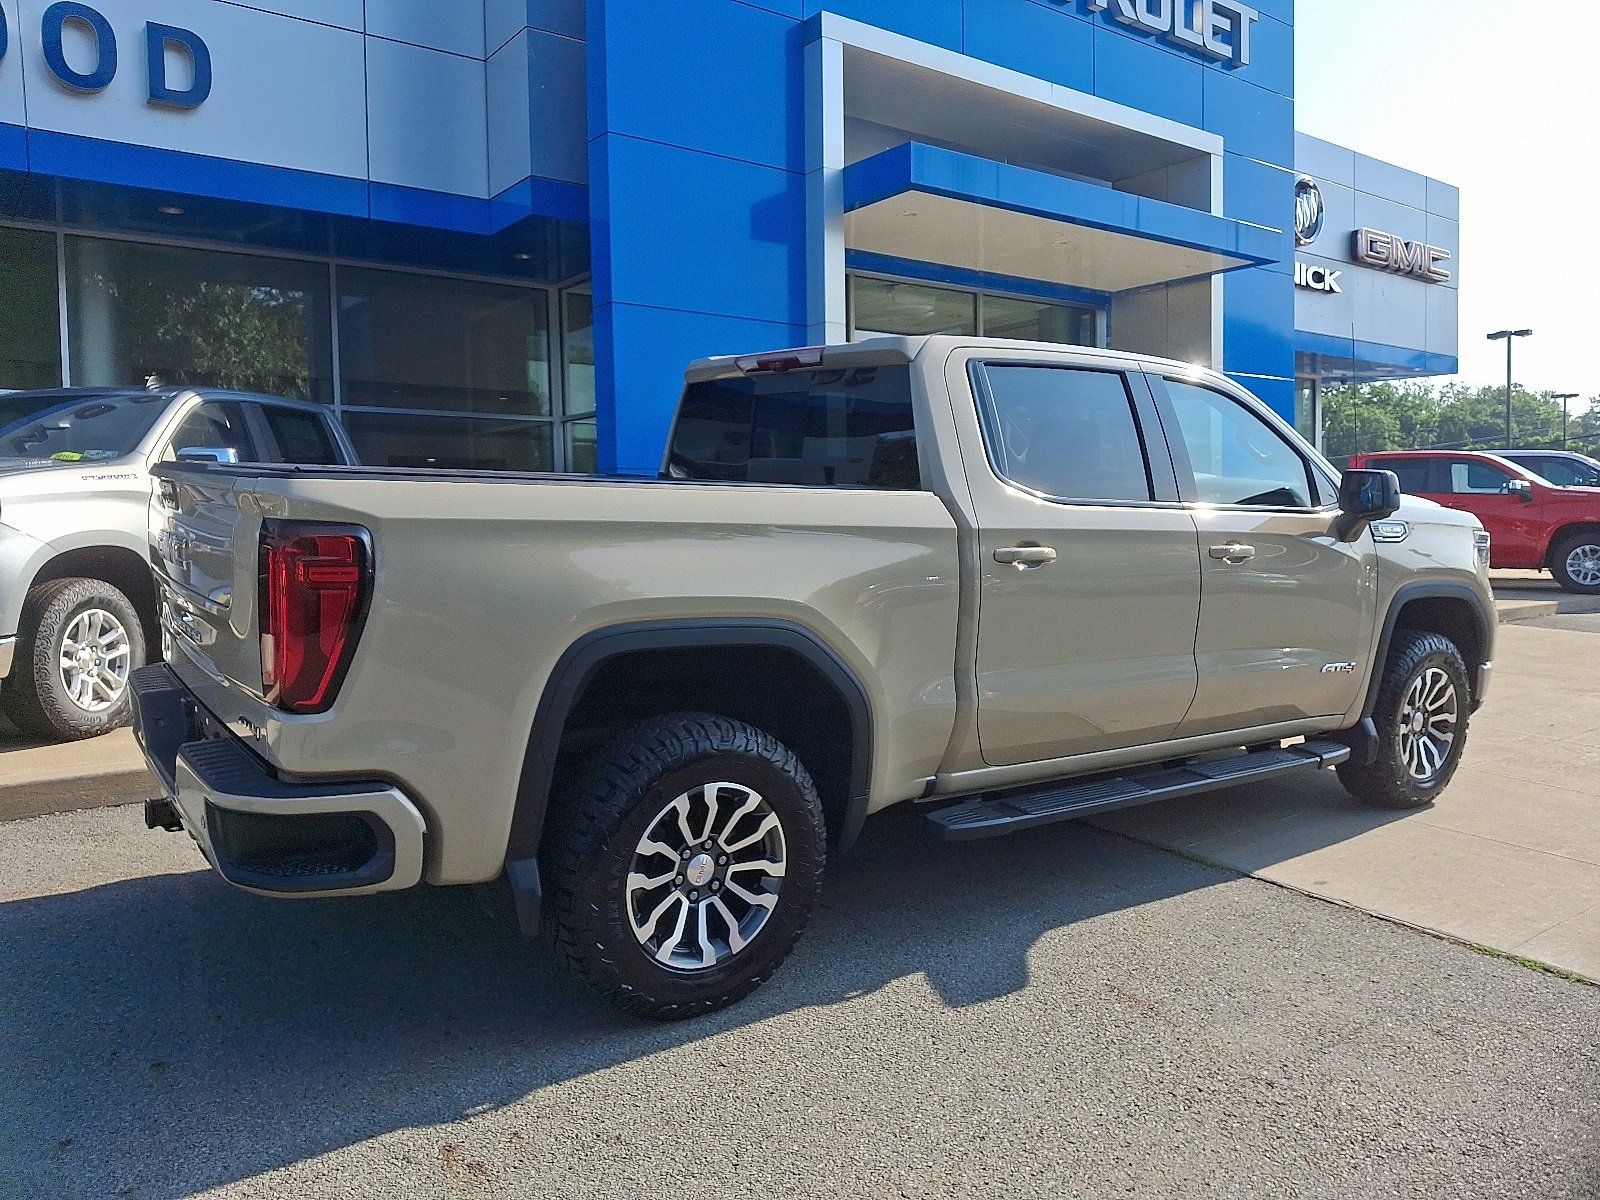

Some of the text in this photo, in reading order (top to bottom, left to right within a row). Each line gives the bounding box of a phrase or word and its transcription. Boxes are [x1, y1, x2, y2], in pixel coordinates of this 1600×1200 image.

[0, 0, 212, 110] OD
[1353, 226, 1452, 283] GMC
[695, 856, 708, 884] GMC
